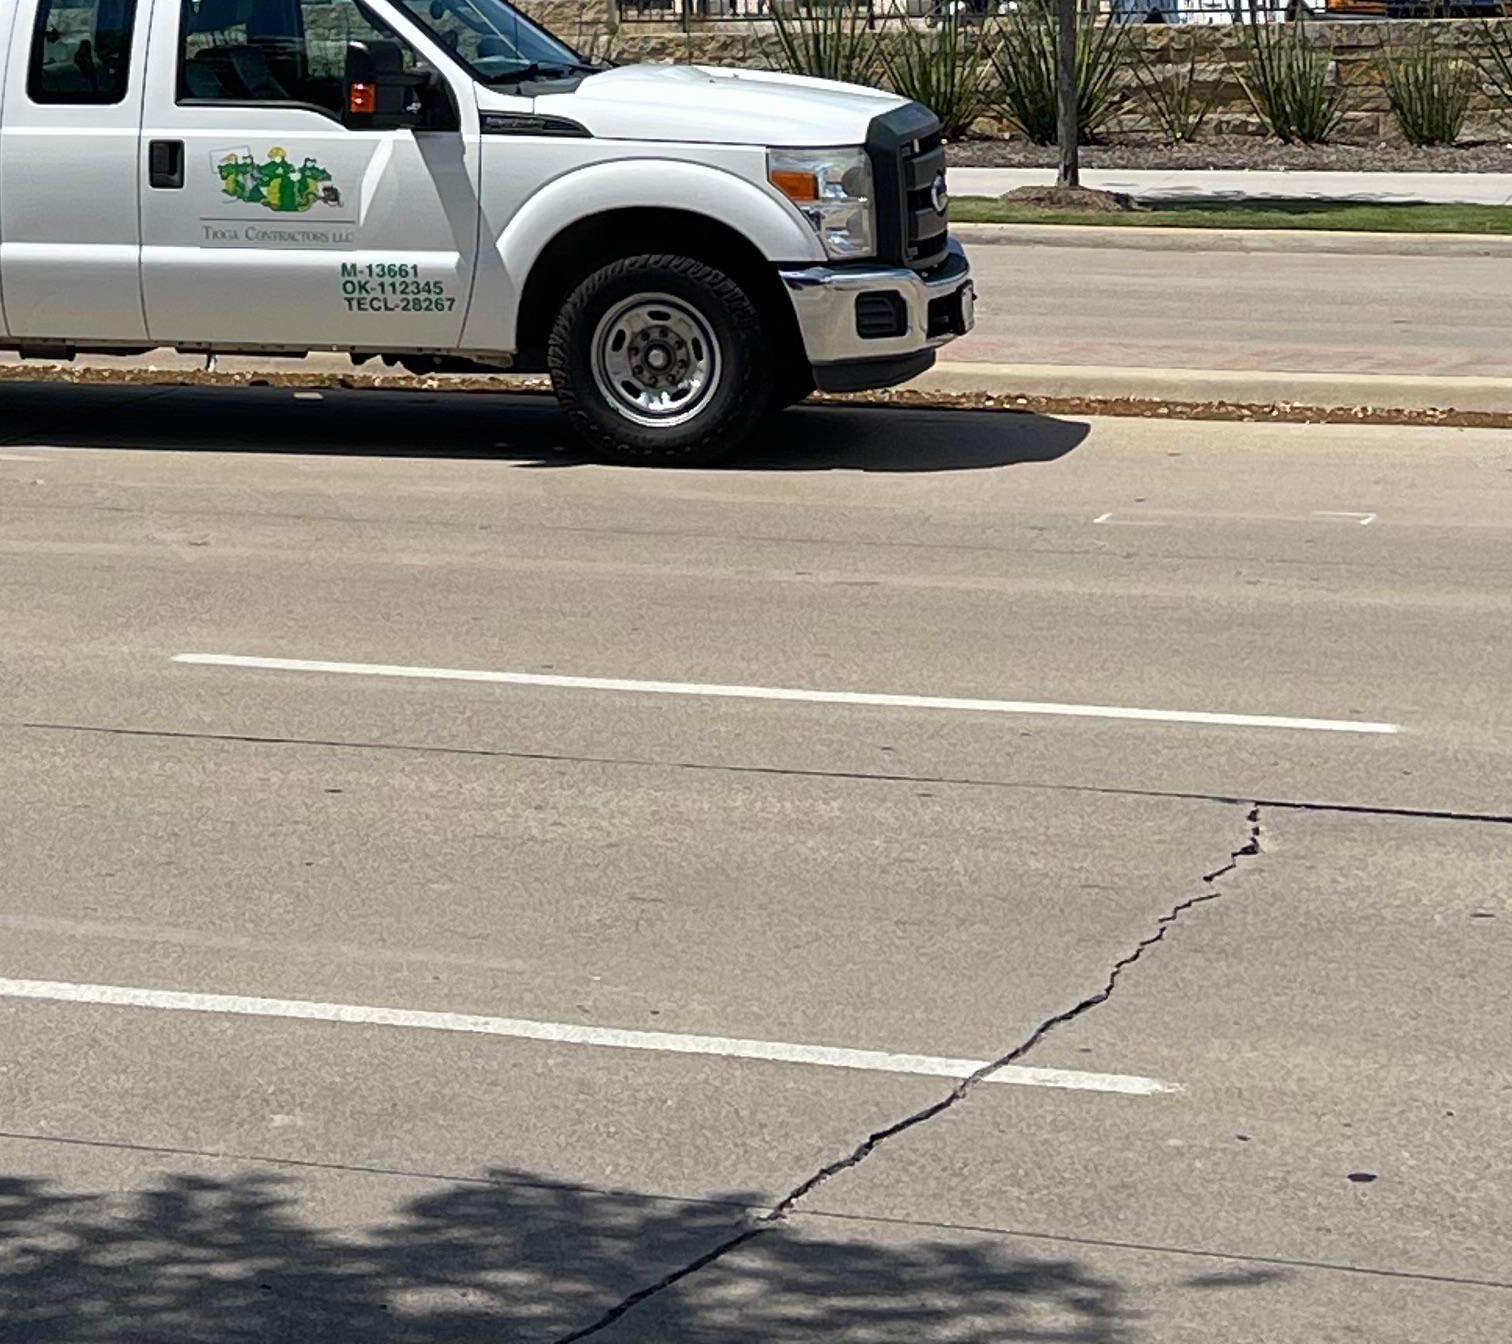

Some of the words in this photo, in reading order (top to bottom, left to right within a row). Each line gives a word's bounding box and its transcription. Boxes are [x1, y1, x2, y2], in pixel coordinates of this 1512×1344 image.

[341, 262, 418, 278] M-13661
[342, 280, 444, 295] OK-112345
[344, 297, 455, 312] TECL-28267
